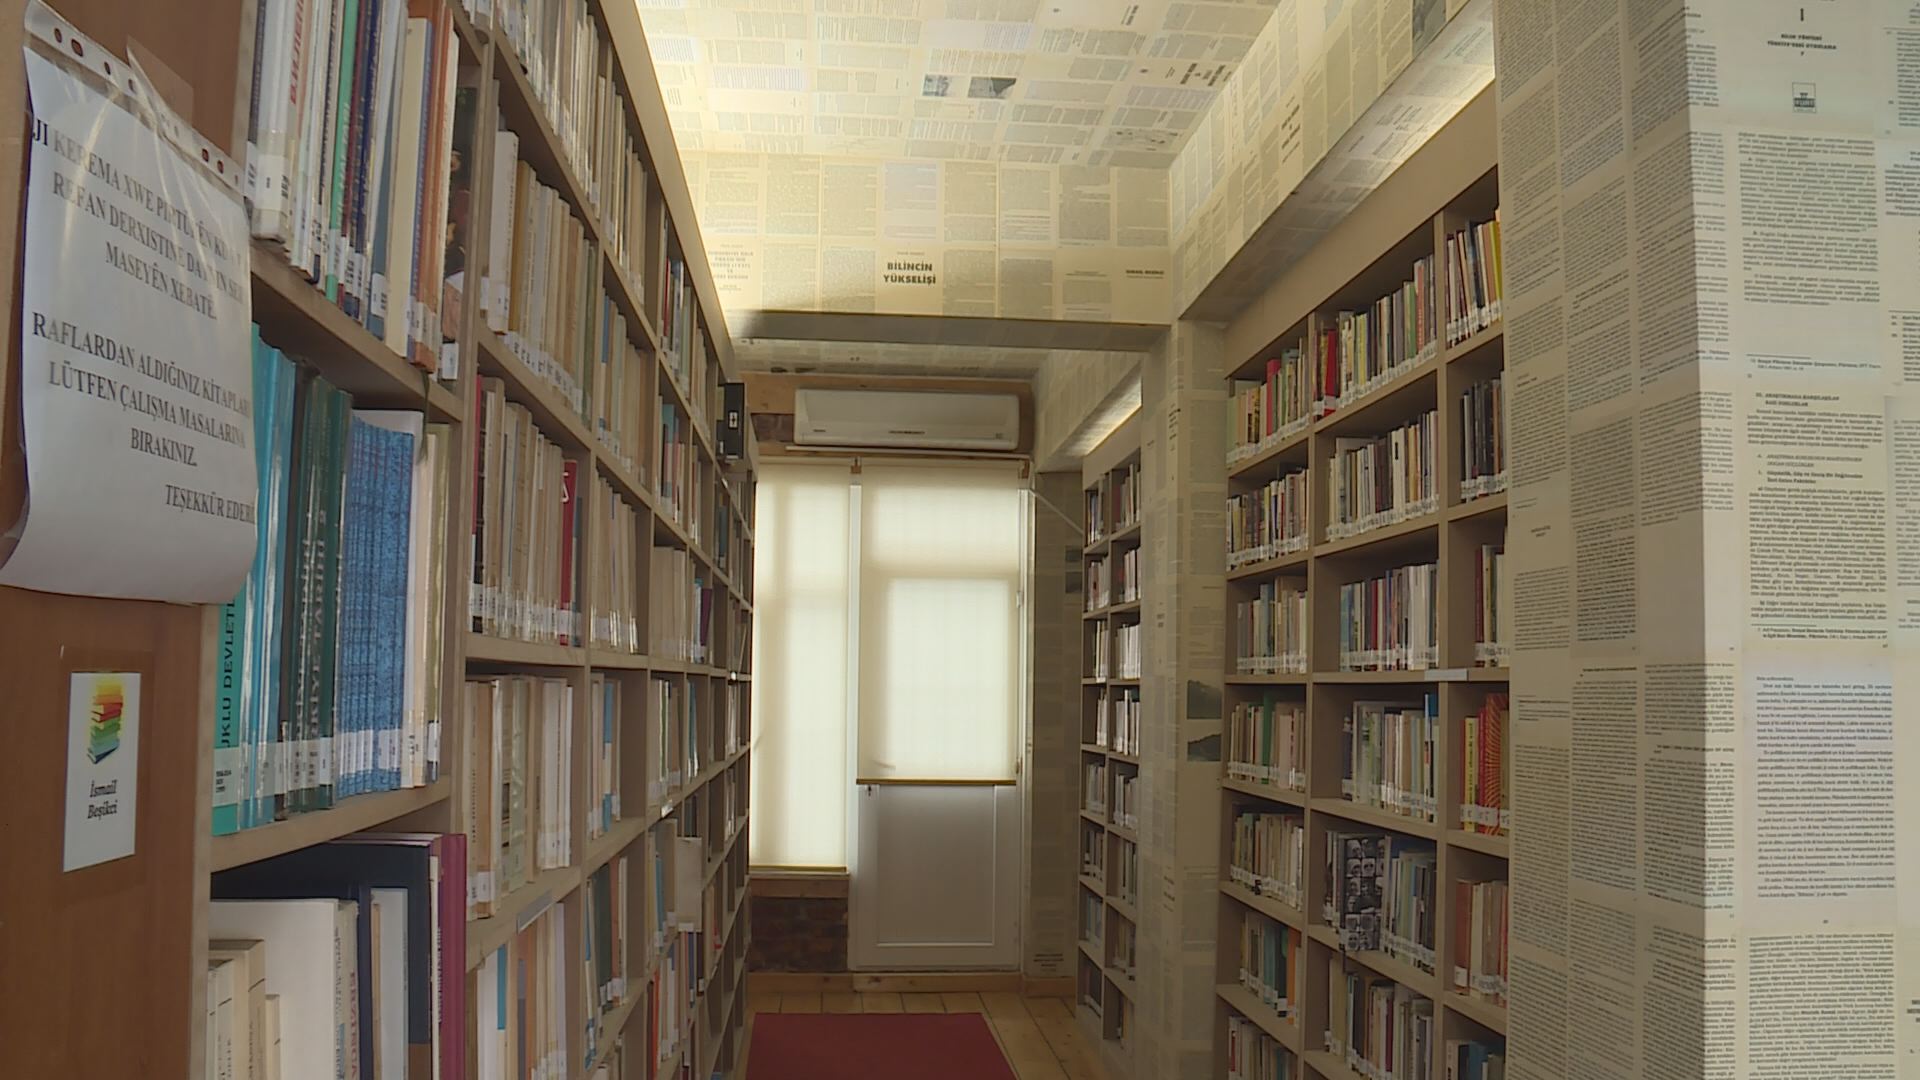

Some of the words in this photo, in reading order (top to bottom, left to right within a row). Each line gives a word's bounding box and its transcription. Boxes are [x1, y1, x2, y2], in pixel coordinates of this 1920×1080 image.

[33, 119, 49, 147] JI
[123, 174, 154, 212] XWE
[105, 241, 168, 293] MASEYÊN
[883, 273, 936, 286] YÜKSELİŞİ
[887, 260, 933, 271] BİLİNCİN
[32, 311, 136, 369] RAFLARDAN
[137, 360, 201, 397] ALDIĞINIZ
[48, 359, 118, 401] LÜTFEN
[119, 384, 177, 424] ÇALIŞMA
[165, 483, 225, 518] TEŞEKKÜR
[89, 779, 119, 798] İsmail
